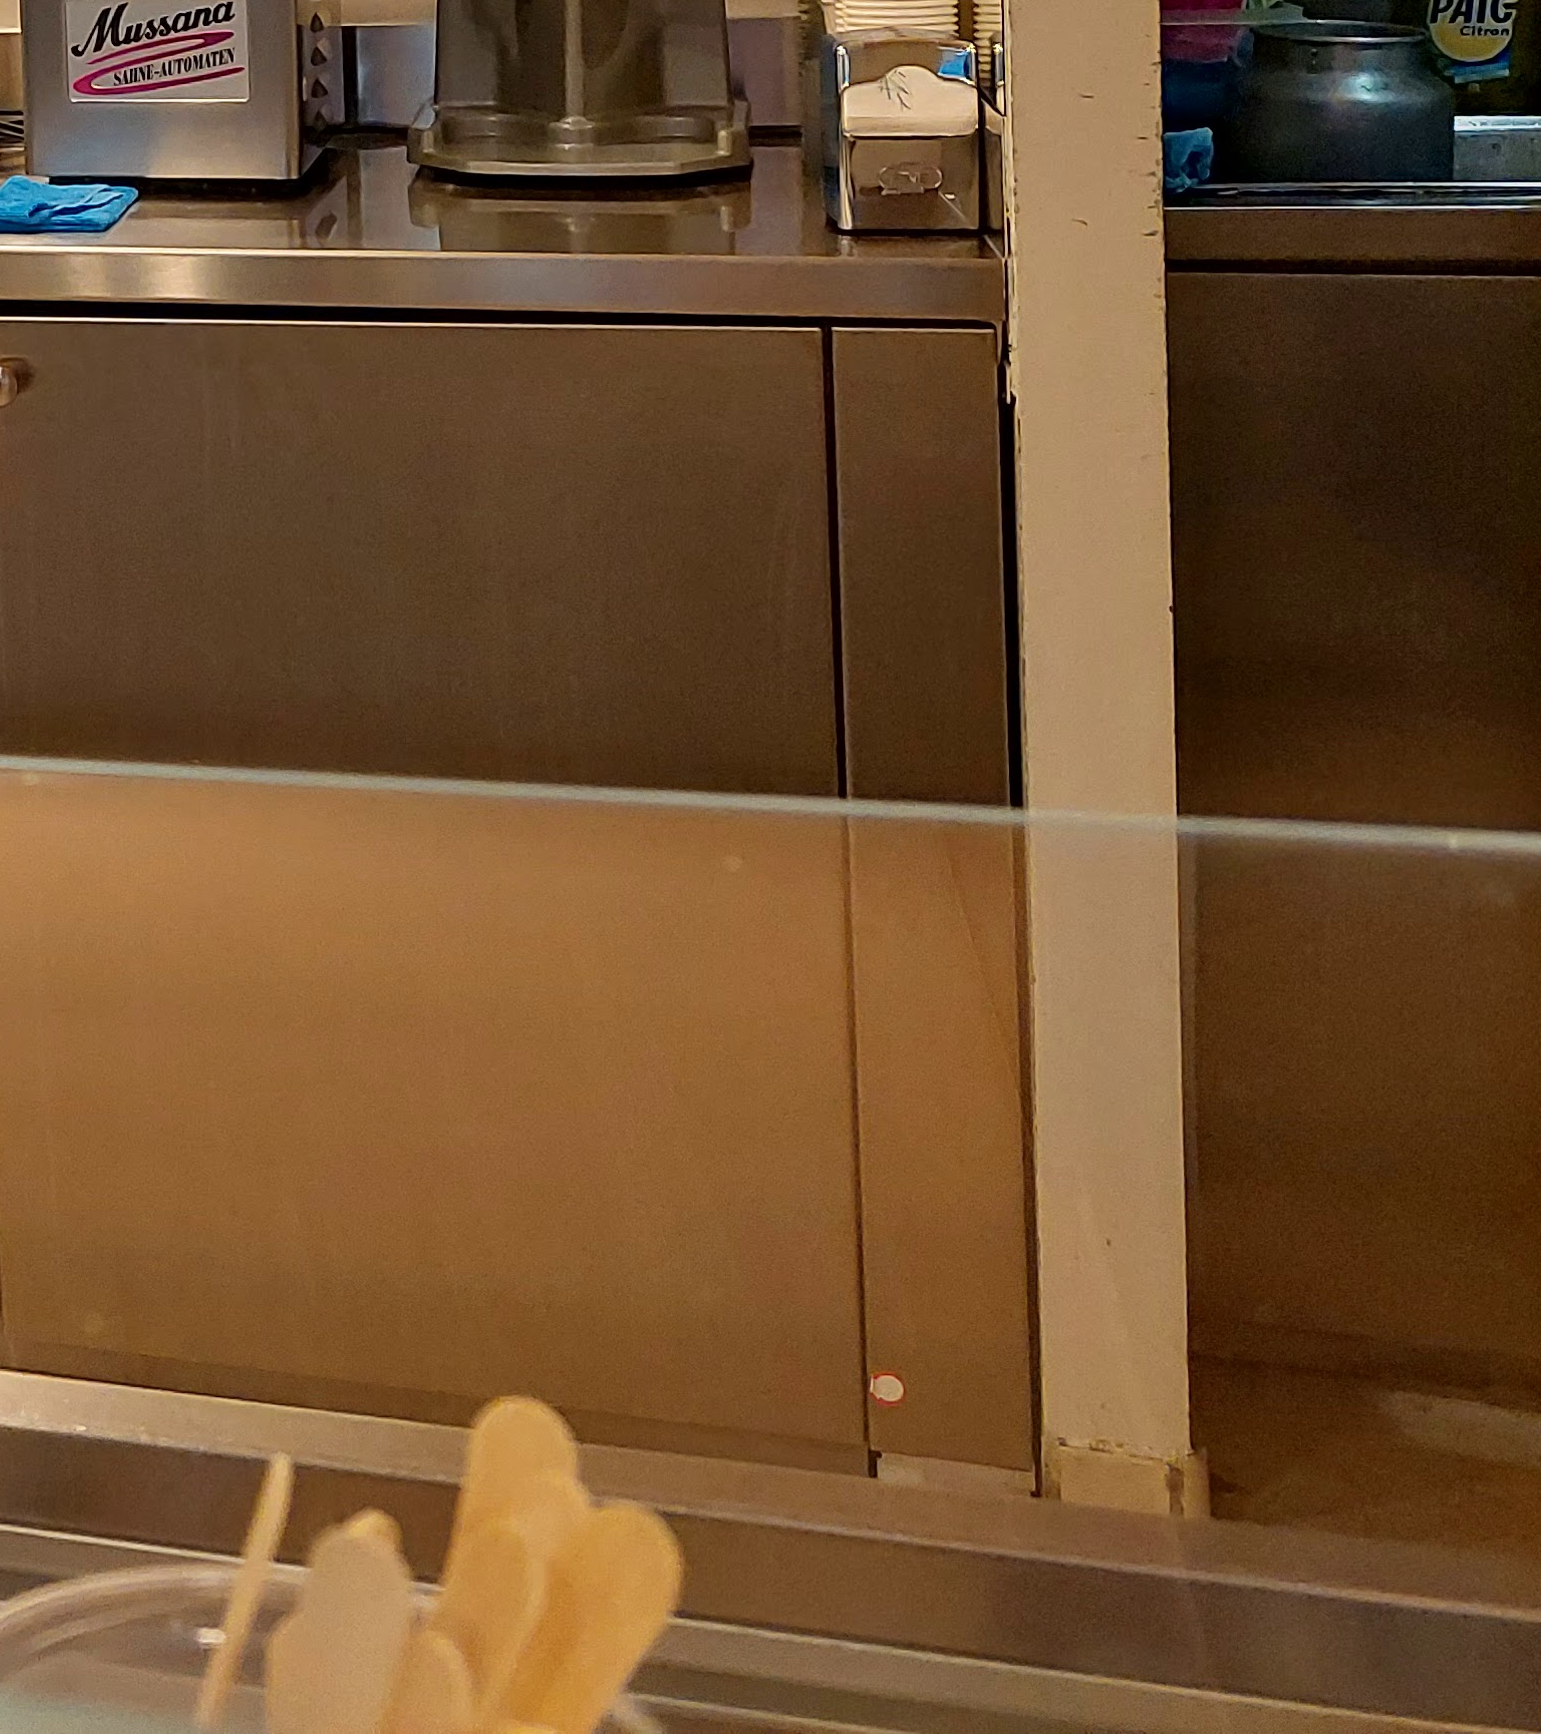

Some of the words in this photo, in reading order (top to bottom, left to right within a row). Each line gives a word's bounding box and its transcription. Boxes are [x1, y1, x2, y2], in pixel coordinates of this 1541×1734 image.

[70, 1, 236, 57] Mussana
[1459, 26, 1510, 36] Citron
[113, 48, 236, 87] SAHNE-AUTOMATEN
